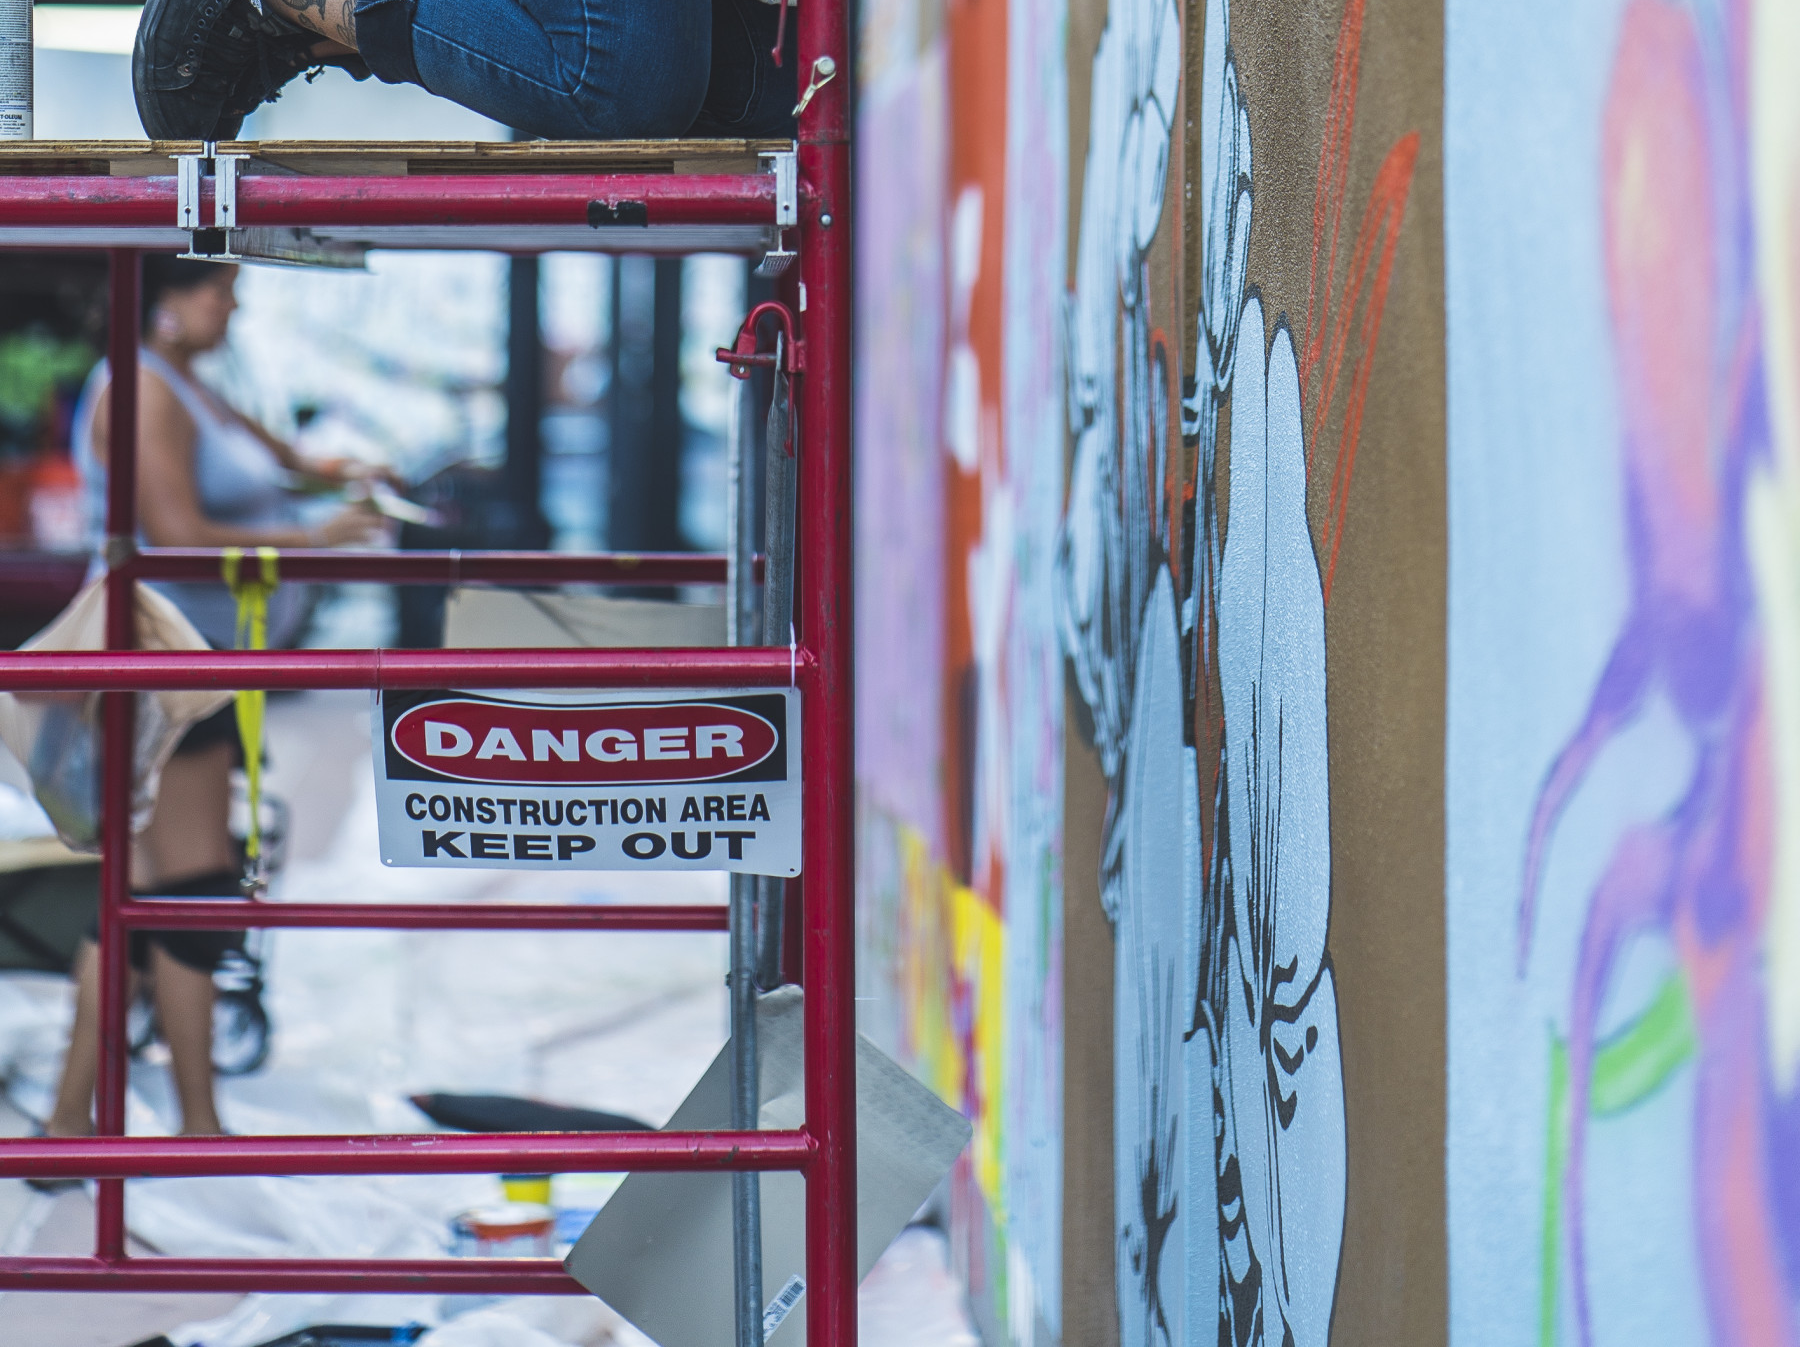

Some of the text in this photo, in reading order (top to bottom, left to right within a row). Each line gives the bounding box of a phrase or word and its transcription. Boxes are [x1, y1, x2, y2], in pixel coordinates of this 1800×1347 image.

[424, 720, 745, 763] DANGER
[404, 792, 771, 827] CONSTRUCTION AREA
[422, 830, 757, 861] KEEP OUT
